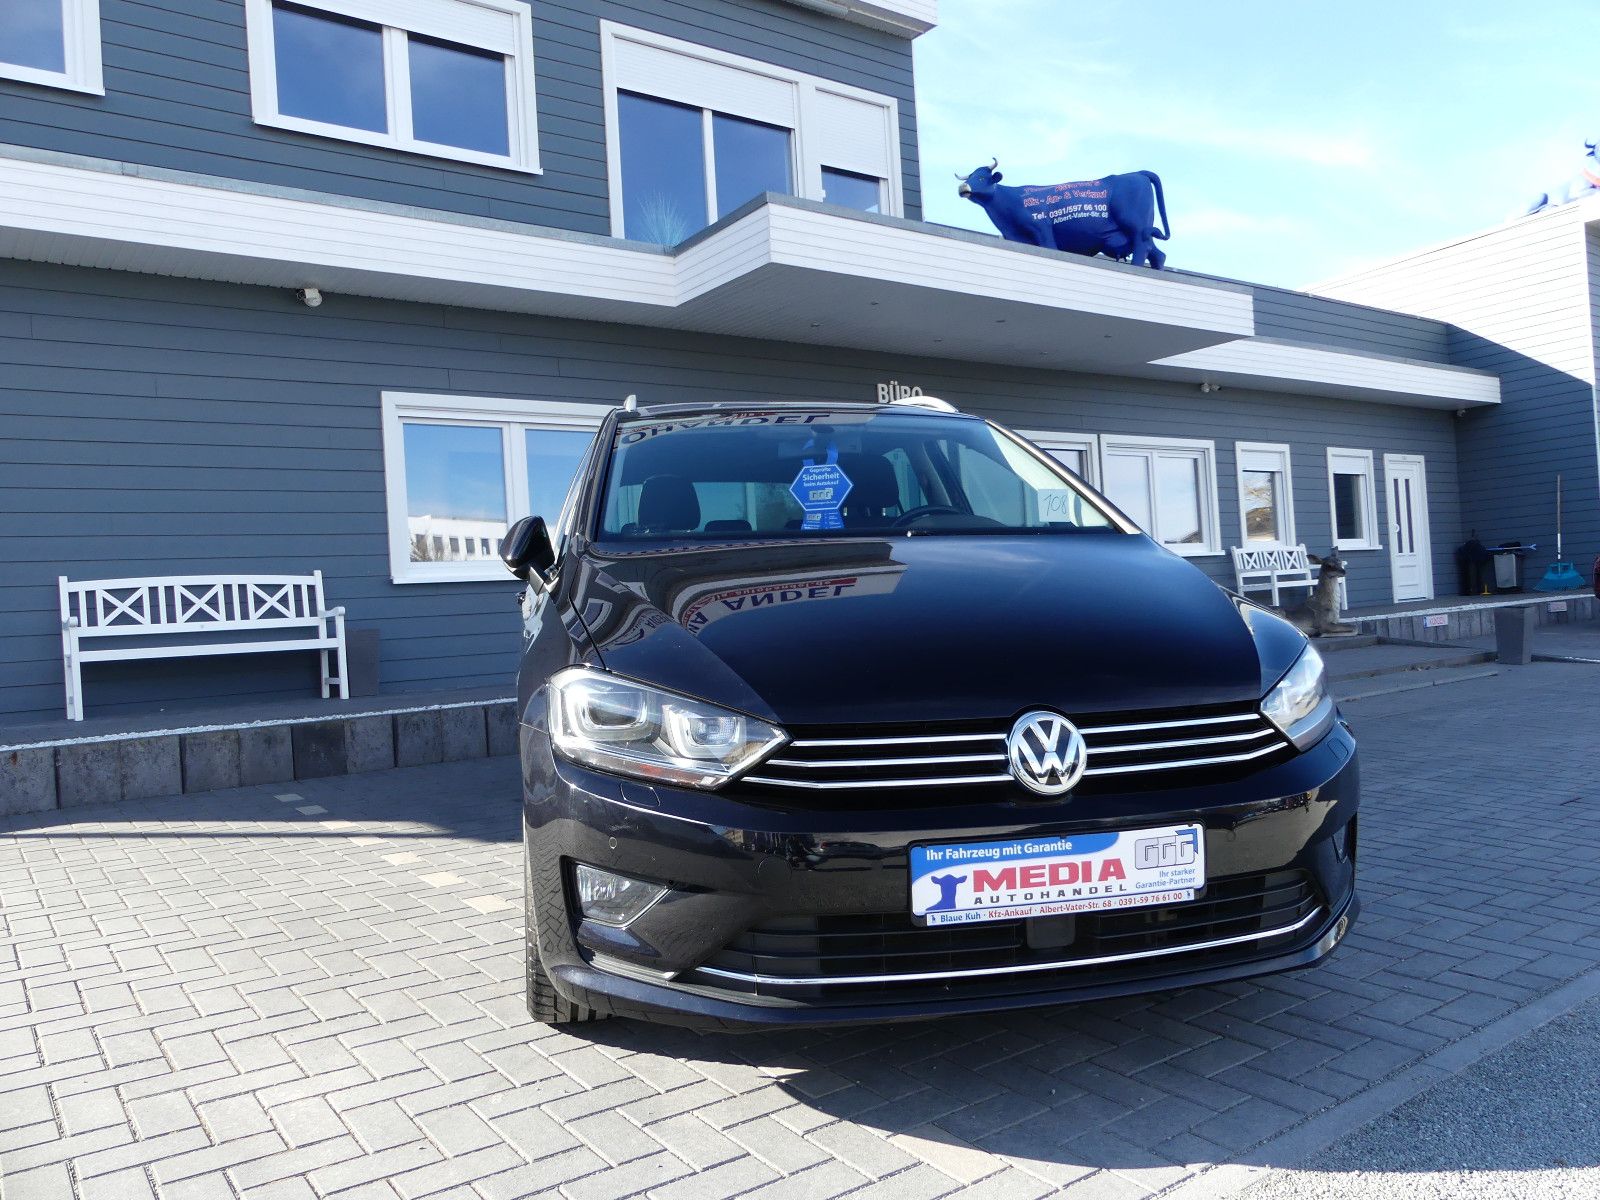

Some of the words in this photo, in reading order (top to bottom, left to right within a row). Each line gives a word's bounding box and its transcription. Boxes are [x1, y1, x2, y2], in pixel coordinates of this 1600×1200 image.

[1032, 211, 1047, 220] Tel.
[1049, 204, 1082, 219] 0391/597
[1094, 204, 1107, 212] 100
[877, 380, 923, 404] BÜRO
[803, 472, 840, 481] Sicherheit
[926, 849, 943, 860] Ihr
[946, 846, 1000, 860] Fahrzeug
[1002, 844, 1022, 856] mit
[1024, 840, 1073, 854] Garantie
[973, 858, 1127, 893] MEDIA
[1136, 877, 1196, 889] Garantie-Partner
[1160, 869, 1169, 878] Ihr
[1171, 868, 1196, 877] starker
[974, 884, 1127, 905] AUTOHANDEL
[940, 913, 963, 923] Blaue
[965, 911, 981, 920] Kuh
[988, 907, 1032, 919] Kfz-Ankauf
[1039, 901, 1099, 915] Albert-Vater-Str.
[1102, 899, 1112, 908] 68
[1118, 896, 1149, 907] 0391-59
[1173, 892, 1183, 900] 00
